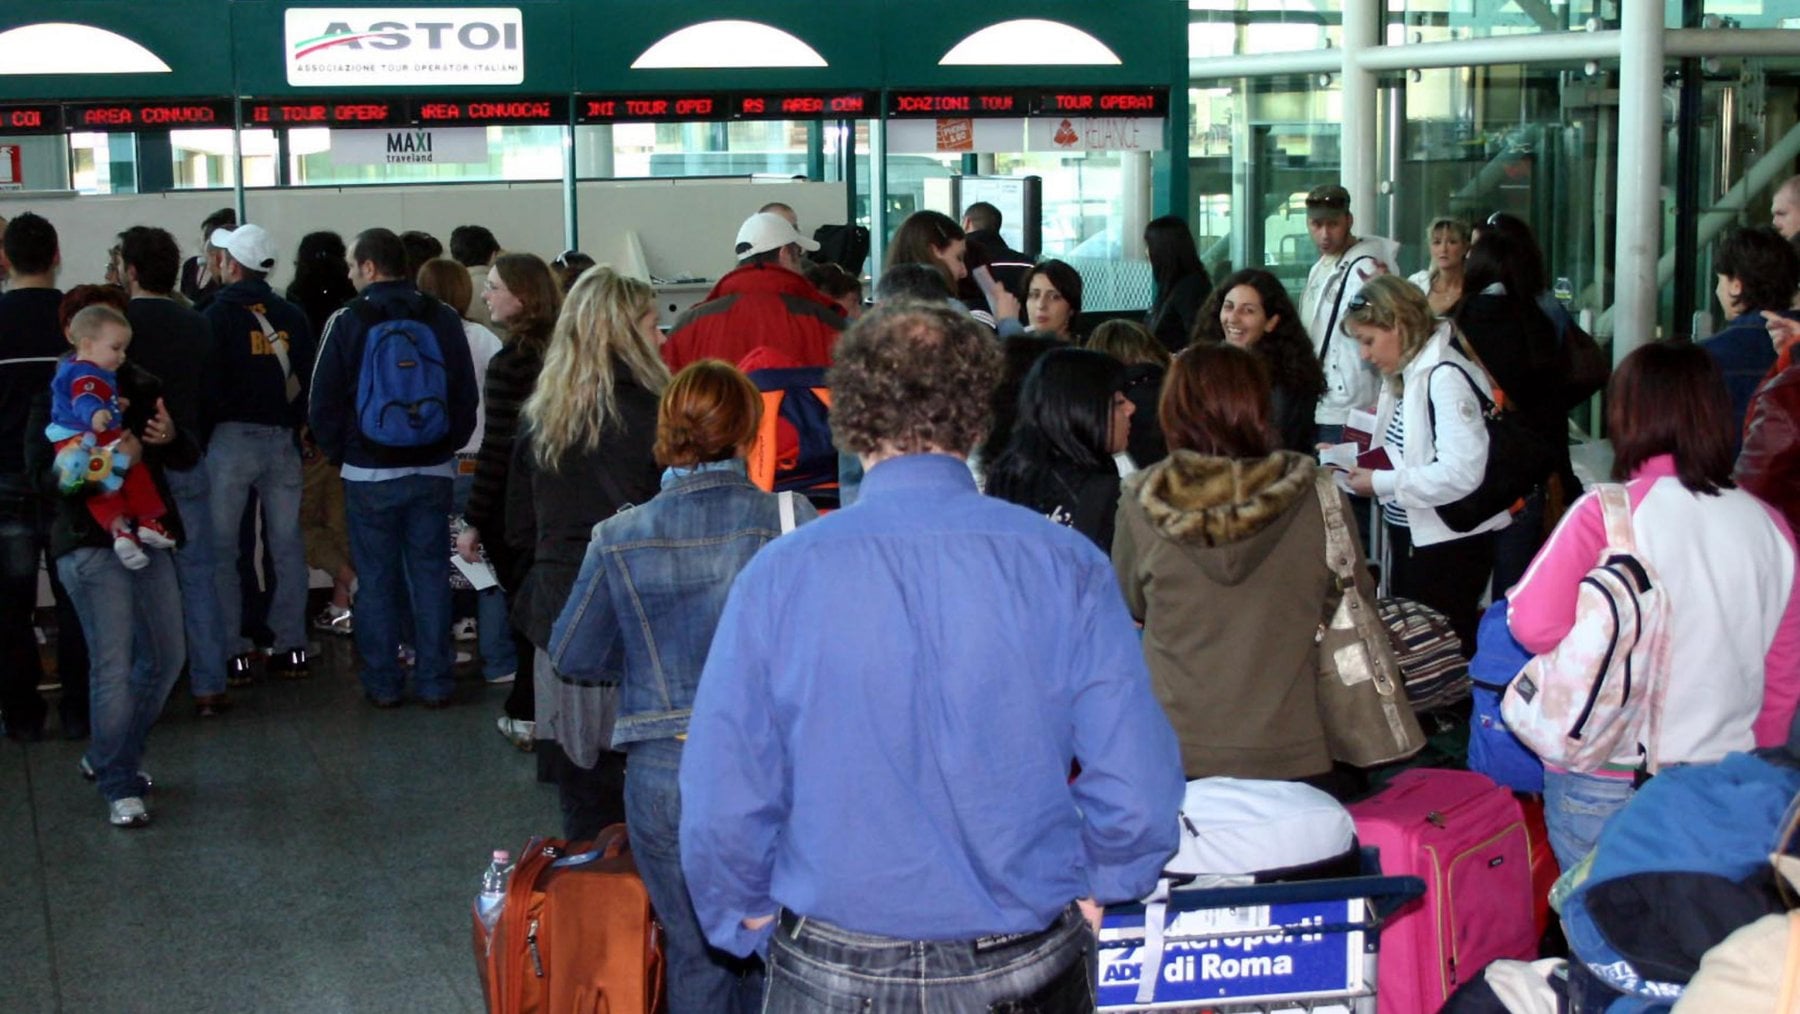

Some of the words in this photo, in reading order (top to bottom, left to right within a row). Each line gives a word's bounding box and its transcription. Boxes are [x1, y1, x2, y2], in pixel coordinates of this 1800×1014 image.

[323, 22, 518, 50] ASTOI
[297, 64, 376, 73] ASSOCIAZIONE
[381, 64, 409, 73] TOUR
[414, 64, 469, 73] OPERATOR
[474, 64, 518, 73] ITALIANI
[625, 100, 668, 115] TOUR
[782, 97, 824, 112] AREA
[1056, 95, 1093, 110] TOUR
[84, 108, 132, 124] AREA
[282, 106, 326, 121] TOUR
[387, 132, 433, 152] MAXI
[387, 153, 433, 163] traveland
[1163, 955, 1195, 983] di
[1201, 952, 1293, 980] Roma
